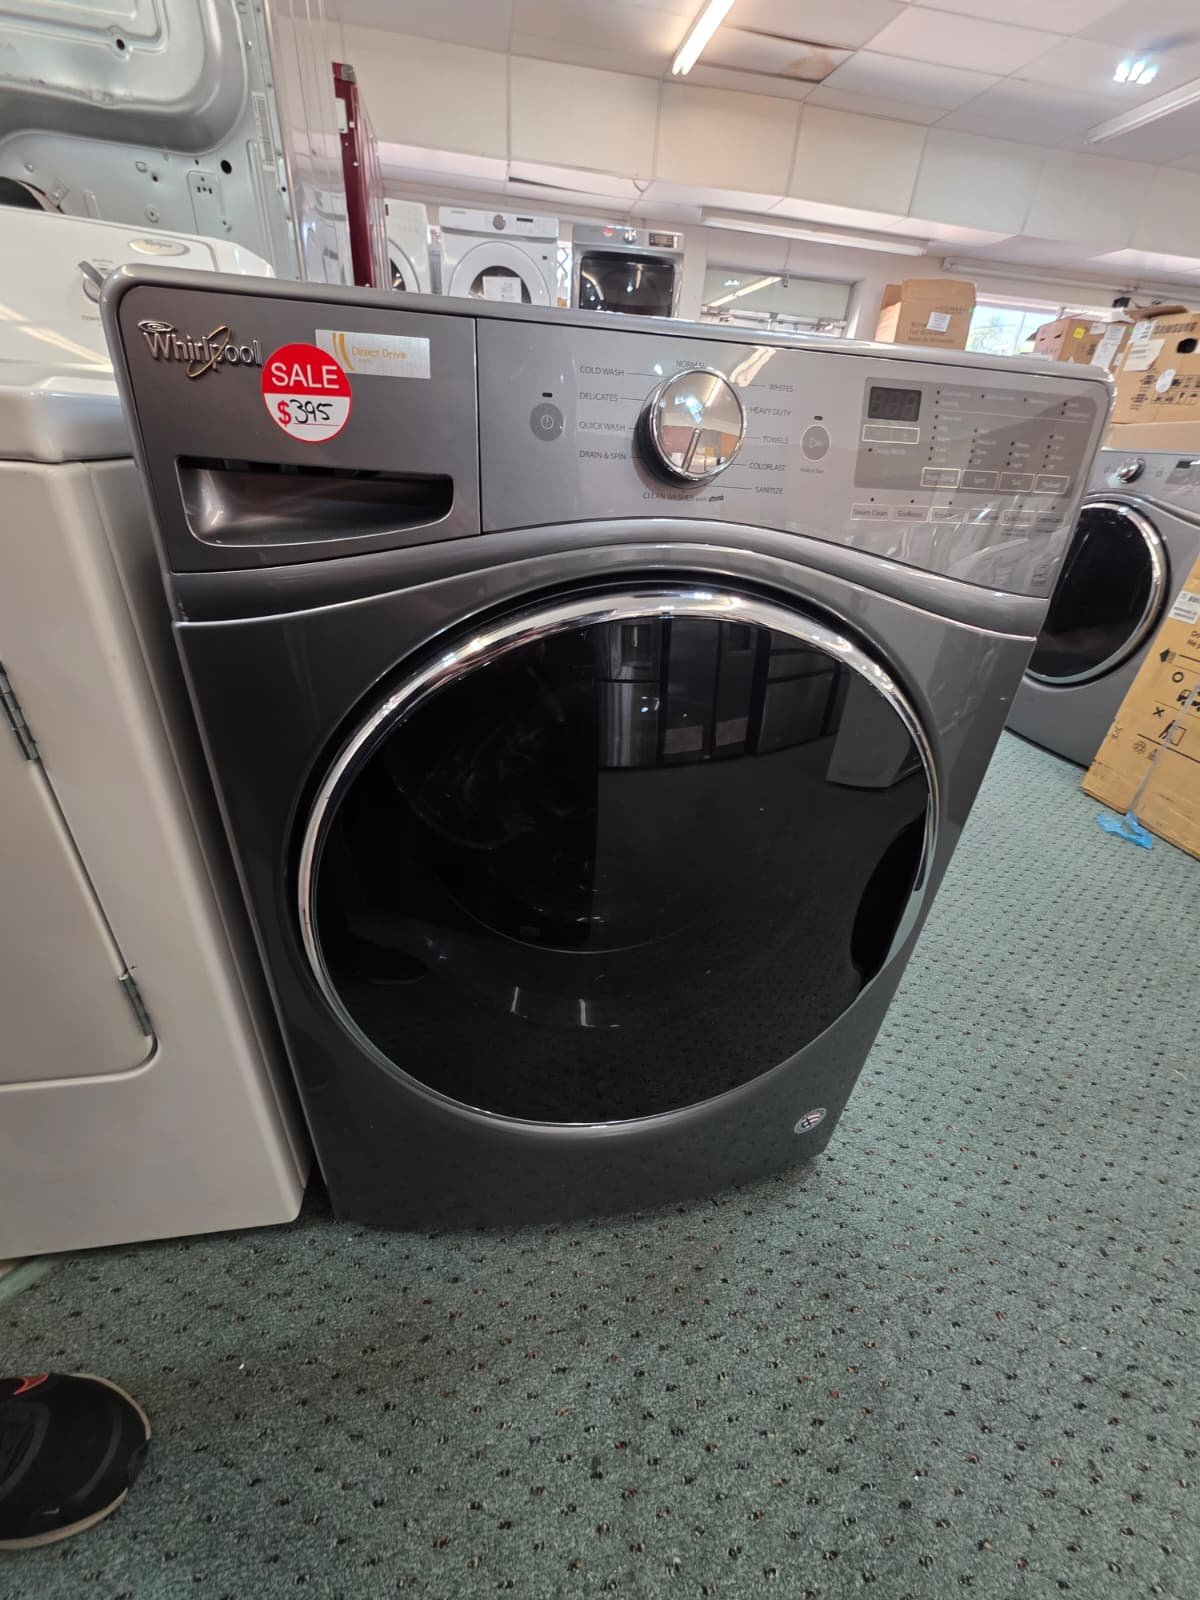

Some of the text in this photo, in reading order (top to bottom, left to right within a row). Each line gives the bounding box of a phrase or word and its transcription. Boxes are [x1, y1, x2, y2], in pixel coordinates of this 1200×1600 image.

[143, 332, 261, 369] Whirlpool
[352, 346, 407, 360] Direct Drive
[271, 362, 340, 389] SALE
[579, 366, 625, 376] COLD WASH
[768, 383, 794, 393] WHITES
[579, 392, 618, 401] DELICATES
[277, 399, 333, 427] $395
[749, 406, 791, 417] HEAVY DUTY
[579, 421, 626, 432] QUICK WASH
[762, 435, 789, 445] TOWELS
[579, 450, 627, 460] DRAIN & SPIN
[755, 486, 783, 495] SANITIZE
